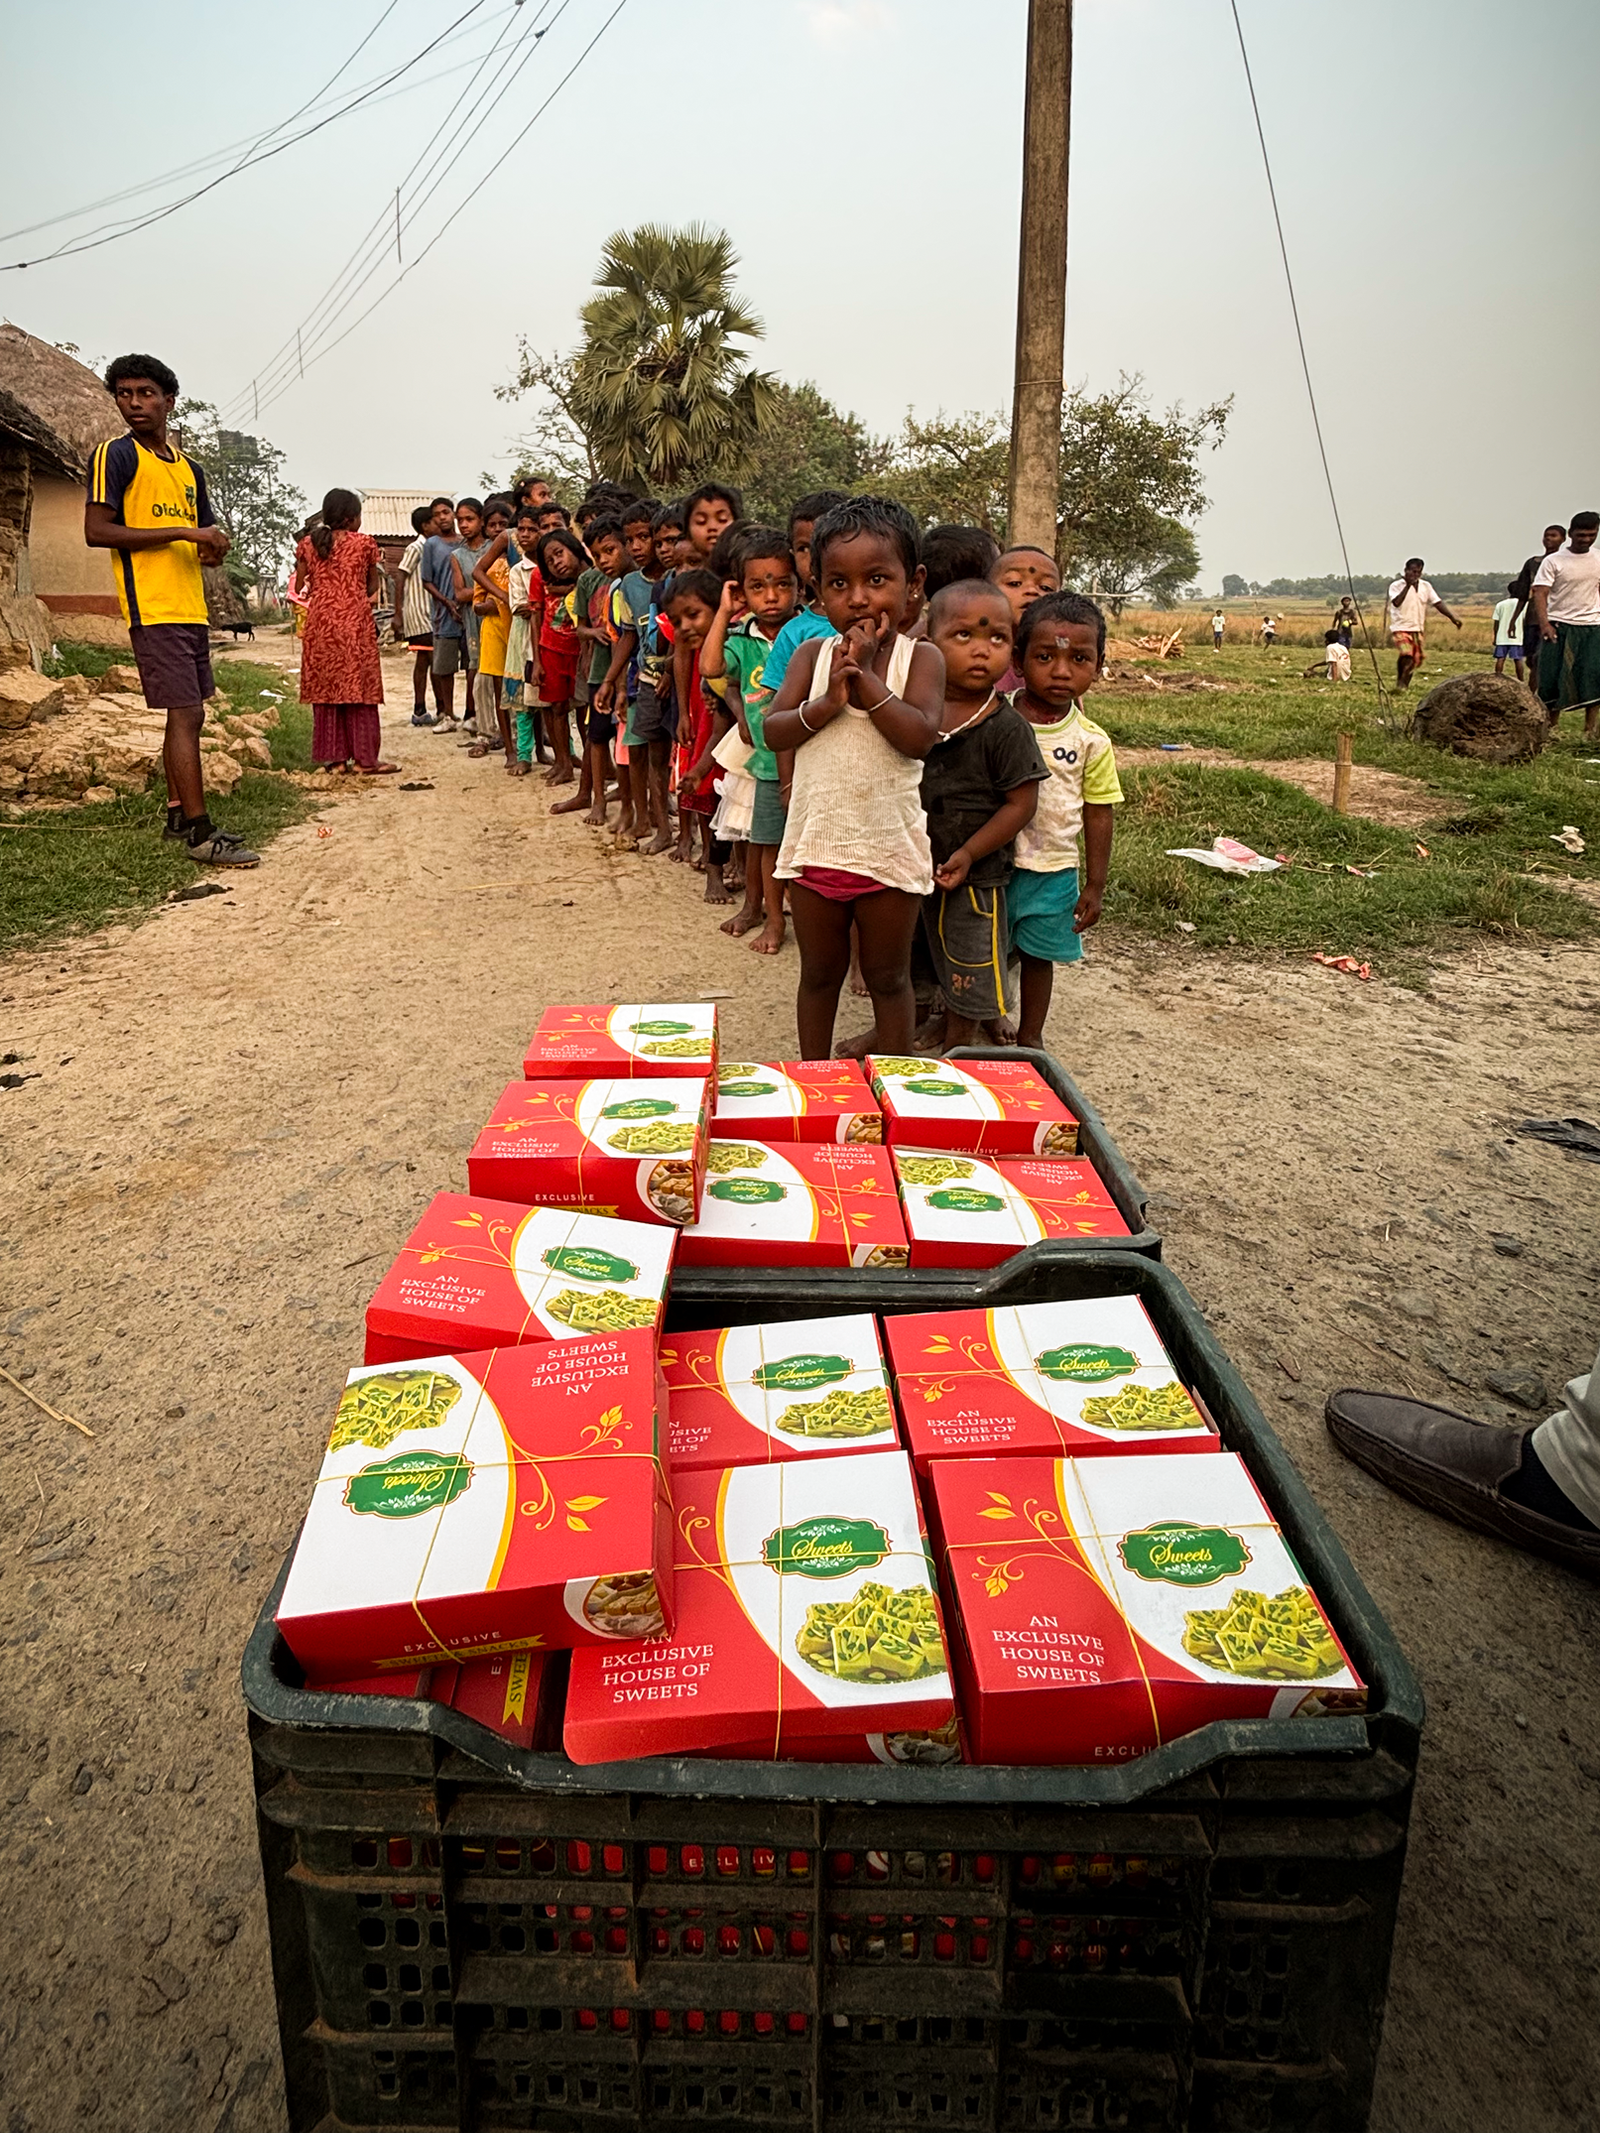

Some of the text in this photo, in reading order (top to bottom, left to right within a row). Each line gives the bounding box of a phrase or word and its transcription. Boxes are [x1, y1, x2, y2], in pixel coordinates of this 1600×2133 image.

[492, 1141, 560, 1149] EXCLUSIVE
[813, 1157, 876, 1165] EXCLUSIVE
[534, 1193, 595, 1202] EXCLUSIVE
[564, 1256, 611, 1273] Sweets
[401, 1278, 486, 1297] EXCLUSIVE
[435, 1275, 460, 1284] AN
[399, 1287, 481, 1305] HOUSE OF
[402, 1297, 467, 1313] SWEETS
[547, 1340, 618, 1359] SWEETS
[535, 1352, 626, 1374] HOUSE OF
[1060, 1356, 1110, 1376] Sweets
[531, 1365, 629, 1388] EXCLUSIVE
[565, 1383, 593, 1396] AN
[926, 1417, 1017, 1427] EXCLUSIVE
[931, 1425, 1017, 1436] HOUSE OF
[686, 1435, 709, 1443] OF
[943, 1433, 1011, 1445] SWEETS
[670, 1444, 698, 1453] ETS
[381, 1469, 446, 1495] Sweets
[790, 1535, 853, 1560] Sweets
[1149, 1542, 1213, 1569] Sweets
[1029, 1615, 1059, 1628] AN
[403, 1631, 502, 1653] EXCUSIVE
[467, 1639, 530, 1655] SNACKS
[642, 1635, 673, 1646] AN
[993, 1630, 1104, 1651] EXCLUSIVE
[601, 1644, 714, 1669] EXCLUSIVE
[1001, 1646, 1105, 1668] HOUSE OF
[510, 1653, 527, 1703] SWEE
[602, 1662, 711, 1686] HOUSE OF
[1016, 1665, 1101, 1683] SWEETS
[612, 1683, 699, 1704] SWEETS
